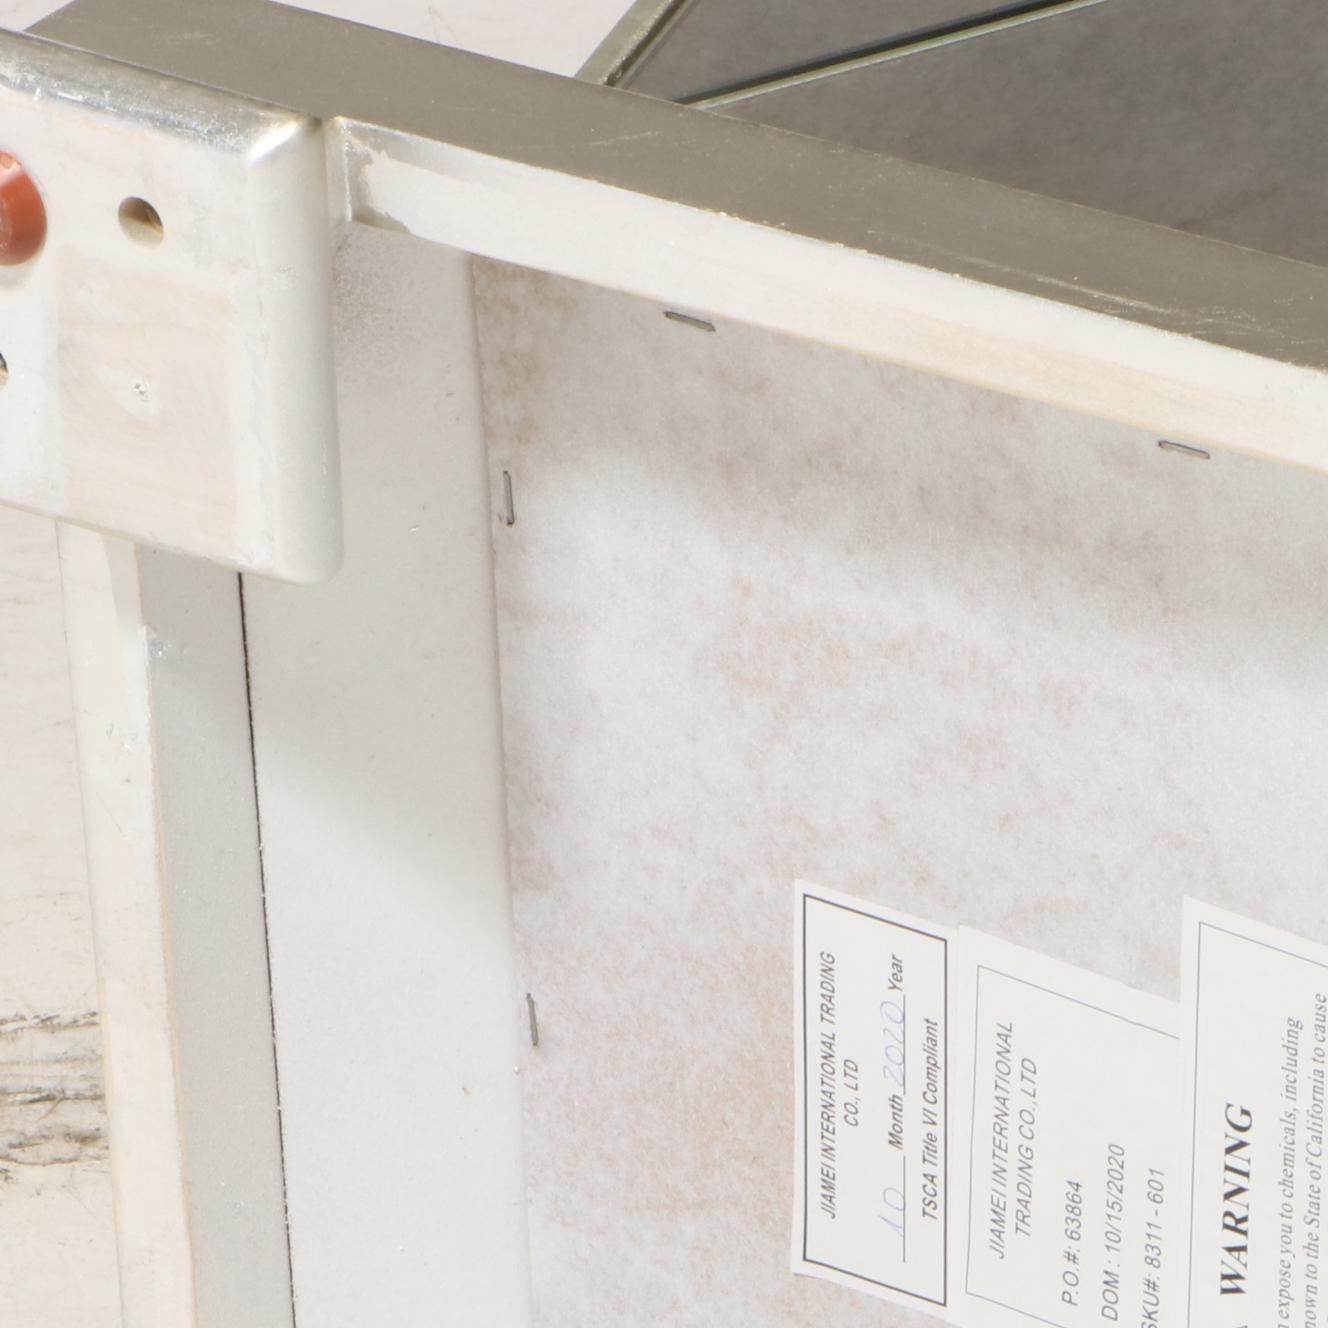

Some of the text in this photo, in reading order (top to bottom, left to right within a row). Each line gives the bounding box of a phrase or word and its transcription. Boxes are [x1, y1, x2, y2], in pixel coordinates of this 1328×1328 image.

[1313, 993, 1327, 1043] cause
[844, 1060, 858, 1091] LTD
[1281, 1017, 1302, 1102] including
[1310, 1046, 1325, 1063] to
[820, 952, 836, 1219] JIAMEI INTERNATIONAL TRADING
[878, 954, 906, 1238] 10 Month 2020 Year
[1306, 1069, 1324, 1157] California
[922, 1018, 940, 1220] TSCA Title VI Compliant
[989, 1022, 1012, 1260] JIAMEI INTERNATIONAL
[1279, 1108, 1298, 1198] chemicals,
[1304, 1156, 1321, 1180] of
[1016, 1145, 1034, 1238] TRADING
[1065, 1180, 1082, 1241] 63864
[1106, 1144, 1124, 1253] 10/15/2020
[1147, 1168, 1164, 1204] 601
[1220, 1102, 1252, 1296] WARNING
[1279, 1202, 1292, 1220] to
[1304, 1184, 1320, 1228] State
[1144, 1222, 1161, 1269] 8311
[1280, 1224, 1296, 1256] you
[1303, 1232, 1318, 1258] the
[1277, 1260, 1292, 1320] expose
[1303, 1262, 1318, 1280] to
